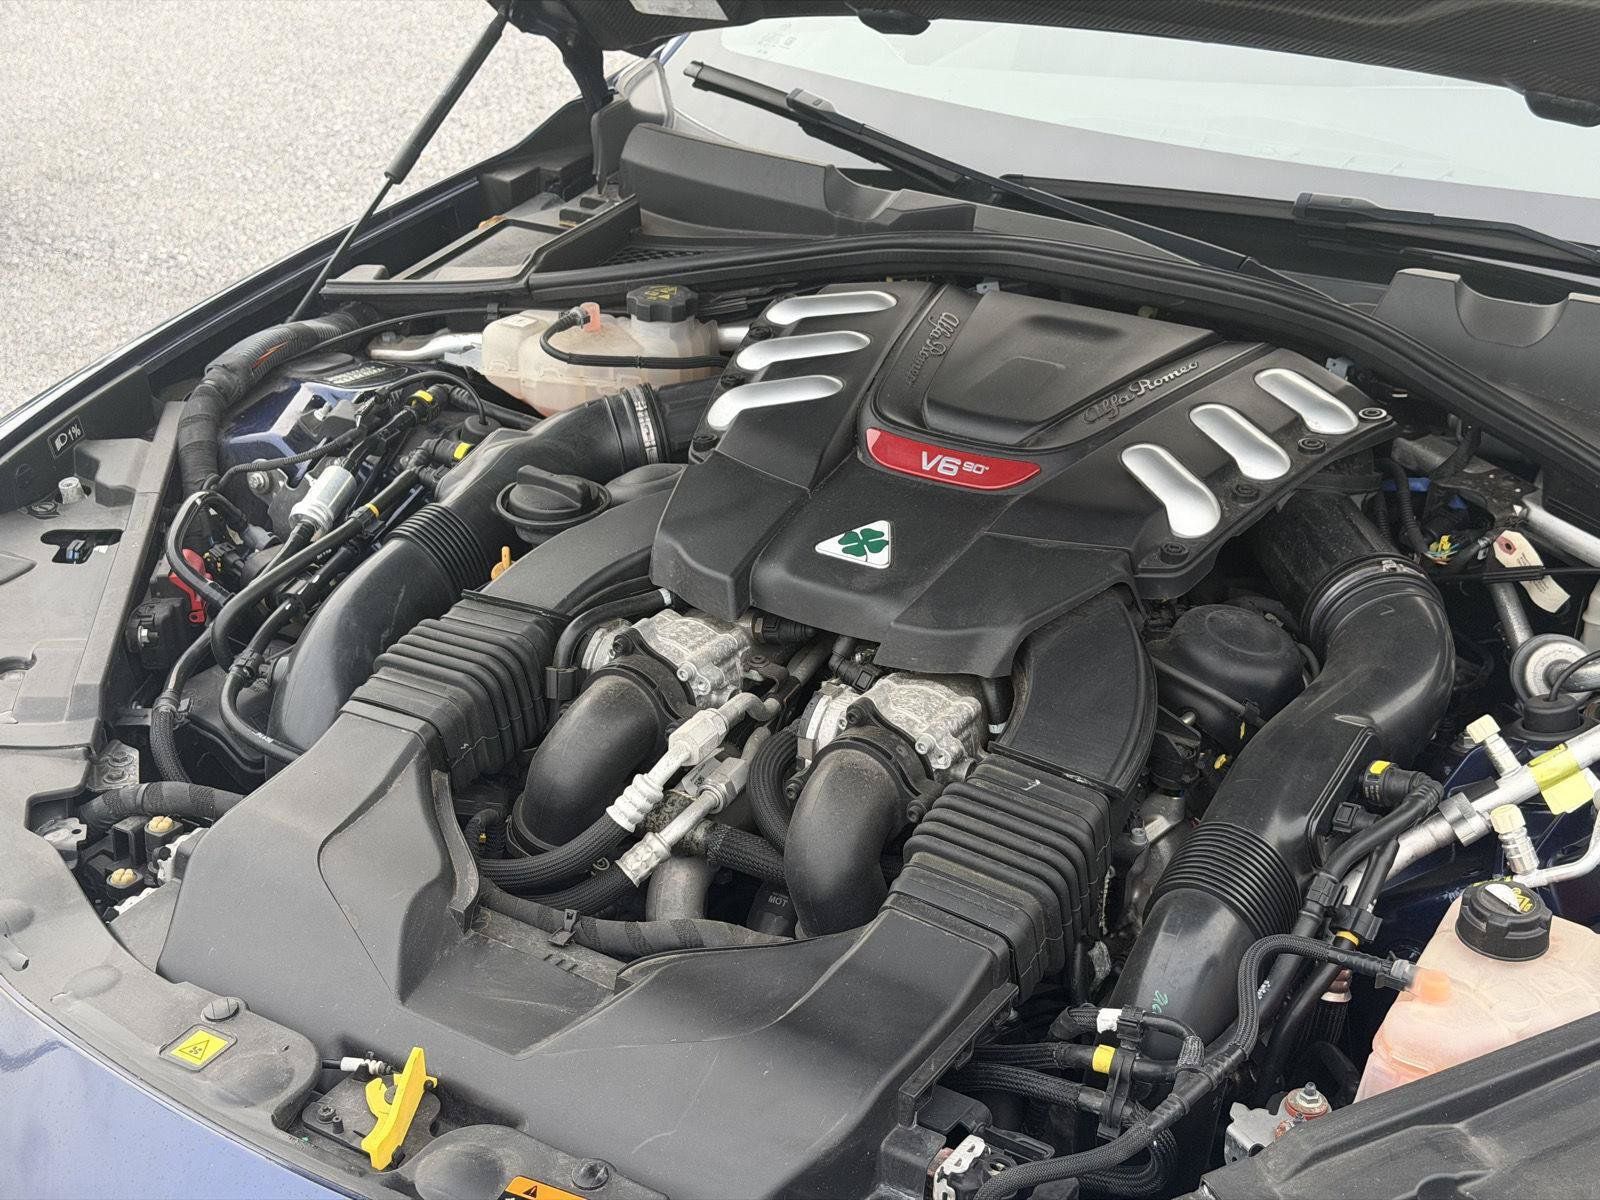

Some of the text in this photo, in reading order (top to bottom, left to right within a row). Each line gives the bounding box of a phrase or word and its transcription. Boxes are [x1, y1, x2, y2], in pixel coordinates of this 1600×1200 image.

[1081, 361, 1199, 424] Alfa Romeo
[68, 424, 82, 441] 1%
[921, 450, 962, 476] V6
